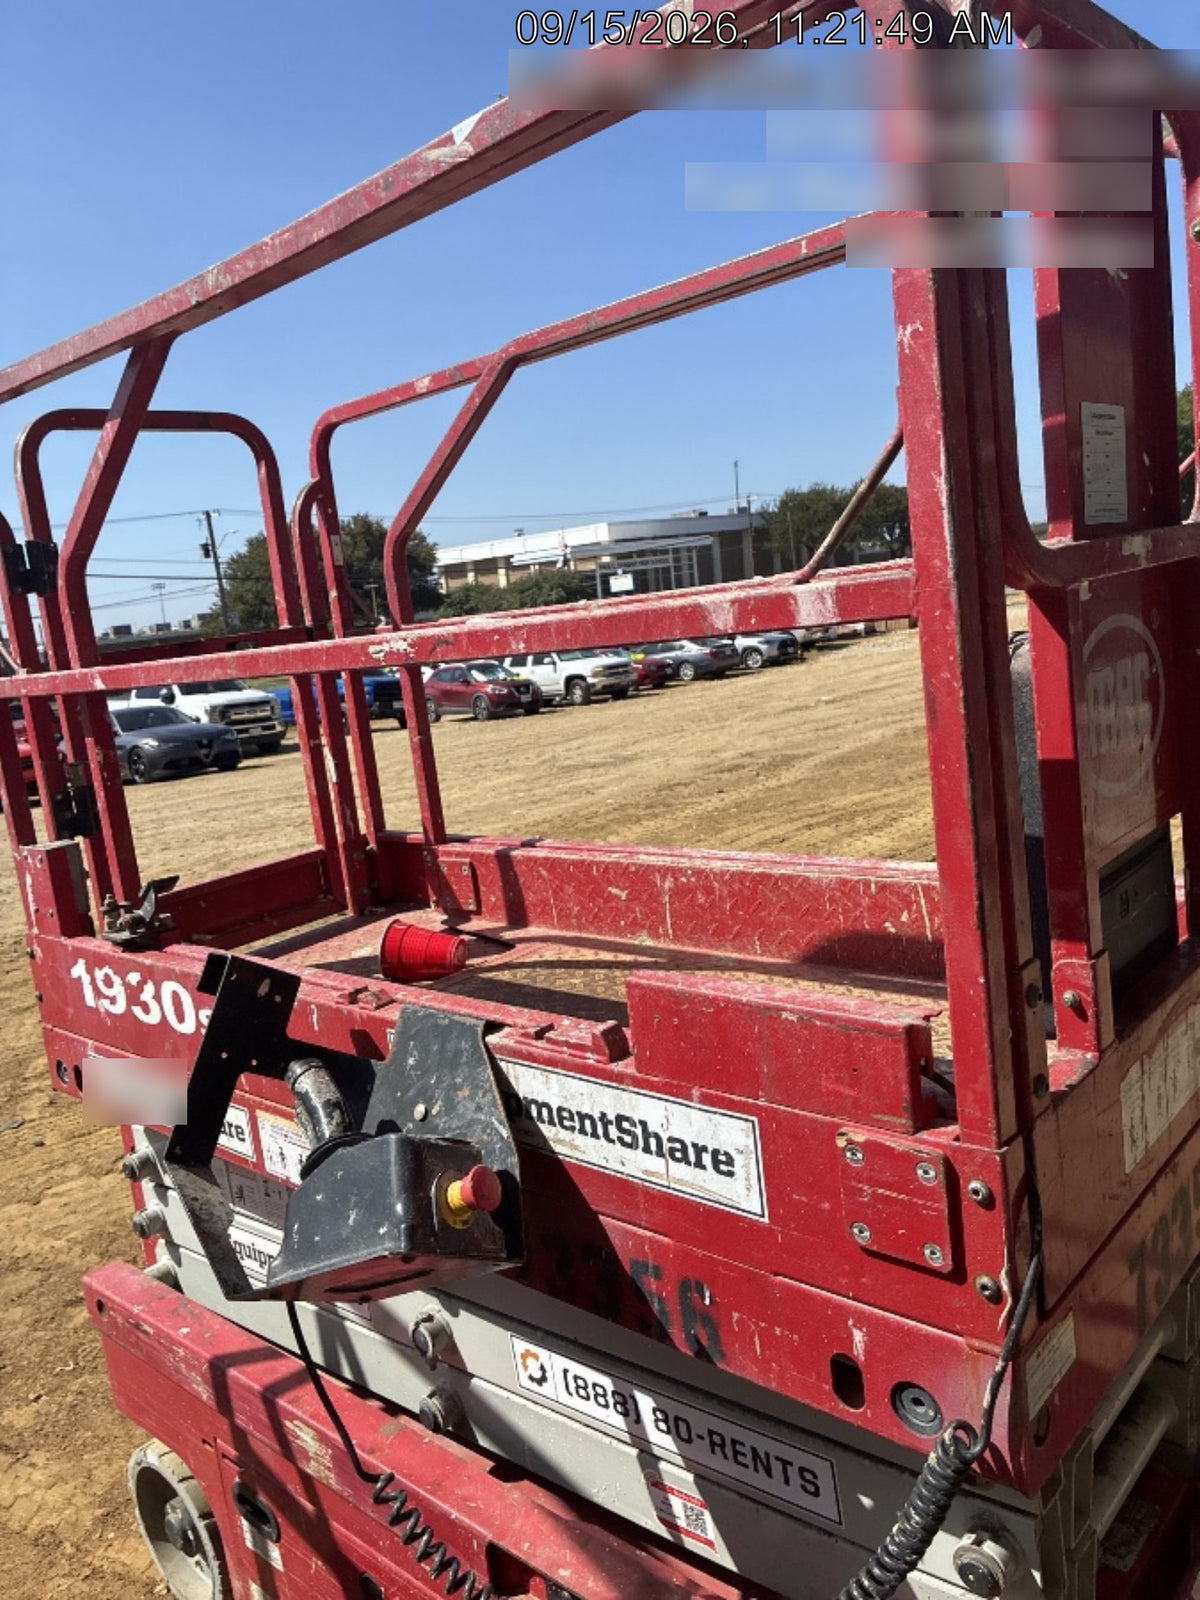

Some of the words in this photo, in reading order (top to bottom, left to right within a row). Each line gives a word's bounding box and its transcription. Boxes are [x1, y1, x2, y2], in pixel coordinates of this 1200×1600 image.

[231, 1240, 276, 1270] quip
[562, 1368, 642, 1424] (888)
[652, 1405, 822, 1498] 80-RENTS
